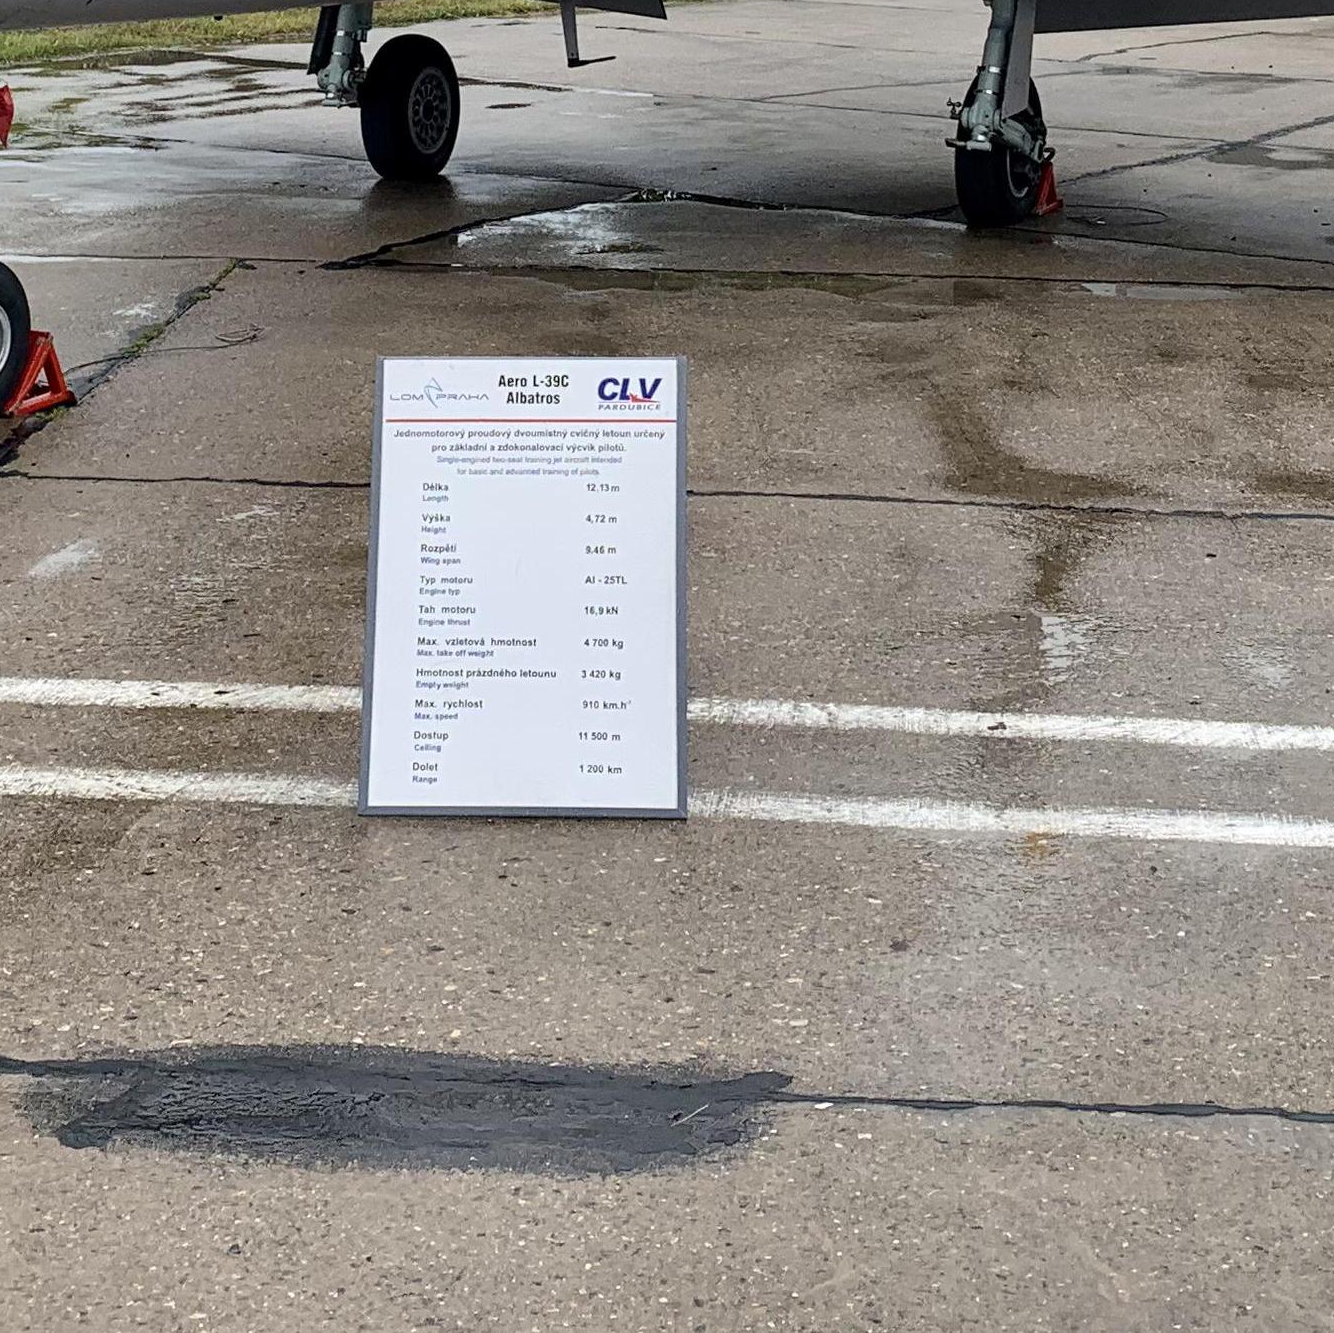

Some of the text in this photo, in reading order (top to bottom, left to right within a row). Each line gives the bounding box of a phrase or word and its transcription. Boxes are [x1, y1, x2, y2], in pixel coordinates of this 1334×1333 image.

[498, 375, 569, 387] Aero L-39C
[597, 377, 663, 401] CLV
[436, 393, 489, 401] PRAHA
[506, 392, 561, 404] Albatros
[393, 429, 666, 440] Jednomotorový proudový dvoumístný cvičný letoun určený
[449, 442, 488, 452] základní
[497, 443, 564, 452] zdokonalovací
[567, 443, 596, 453] výcvik
[422, 482, 449, 492] Délka
[610, 484, 620, 492] m
[422, 495, 449, 503] Length
[585, 514, 606, 524] 4,72
[420, 543, 457, 554] Rozpětí
[607, 546, 617, 554] m
[420, 556, 461, 566] Wing span
[420, 575, 436, 585] Typ
[441, 576, 474, 584] motoru
[604, 575, 628, 585] 25TL
[419, 587, 461, 596] Engine typ
[418, 605, 436, 614] Tah
[441, 606, 476, 614] motoru
[606, 606, 619, 615] kN
[418, 618, 471, 627] Engine thrust
[445, 636, 485, 646] vzletová
[490, 638, 537, 647] hmotnost
[612, 639, 624, 650] kg
[436, 649, 453, 657] take
[455, 649, 467, 657] off
[468, 650, 494, 658] weight
[416, 668, 464, 677] Hmotnost
[466, 668, 517, 679] prázdného
[519, 669, 557, 678] letounu
[609, 670, 621, 681] kg
[415, 681, 469, 690] Empty weight
[415, 699, 437, 708] Max.
[443, 699, 484, 710] rychlost
[582, 700, 600, 709] 910
[435, 712, 459, 721] speed
[413, 730, 449, 741] Dostup
[611, 733, 621, 741] m
[414, 744, 442, 753] Ceiling
[412, 762, 438, 771] Dolet
[607, 765, 623, 774] km
[412, 775, 438, 785] Range
